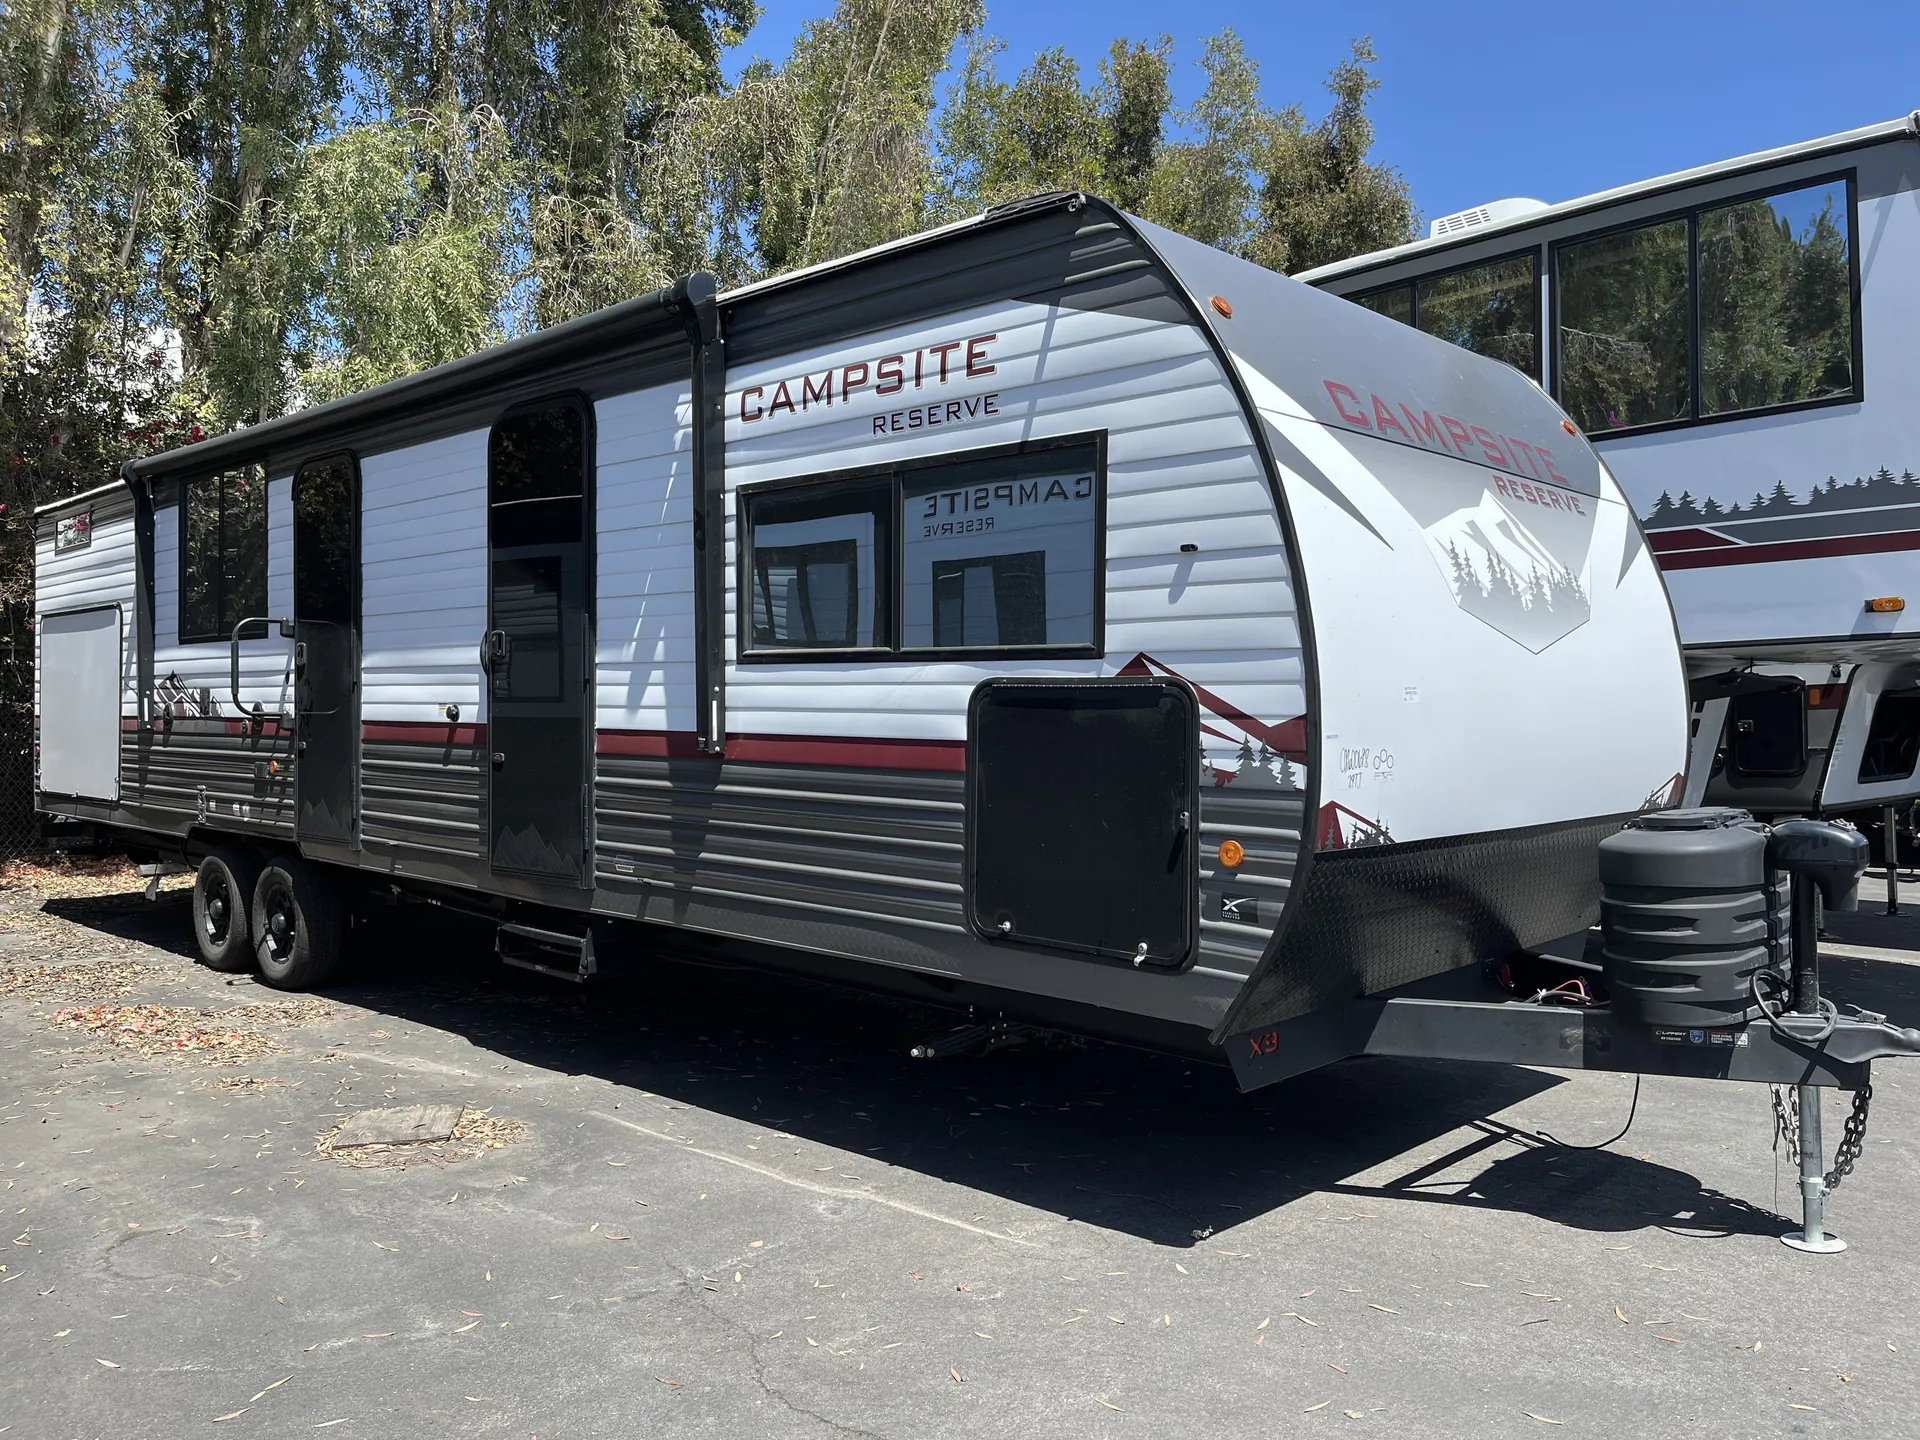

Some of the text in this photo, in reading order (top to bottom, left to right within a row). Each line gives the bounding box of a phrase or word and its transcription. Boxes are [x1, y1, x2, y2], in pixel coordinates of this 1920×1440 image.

[740, 333, 998, 423] CAMPSITE
[872, 394, 1000, 436] RESERVE
[1322, 379, 1570, 484] CAMPSITE
[1492, 475, 1587, 517] RESERVE
